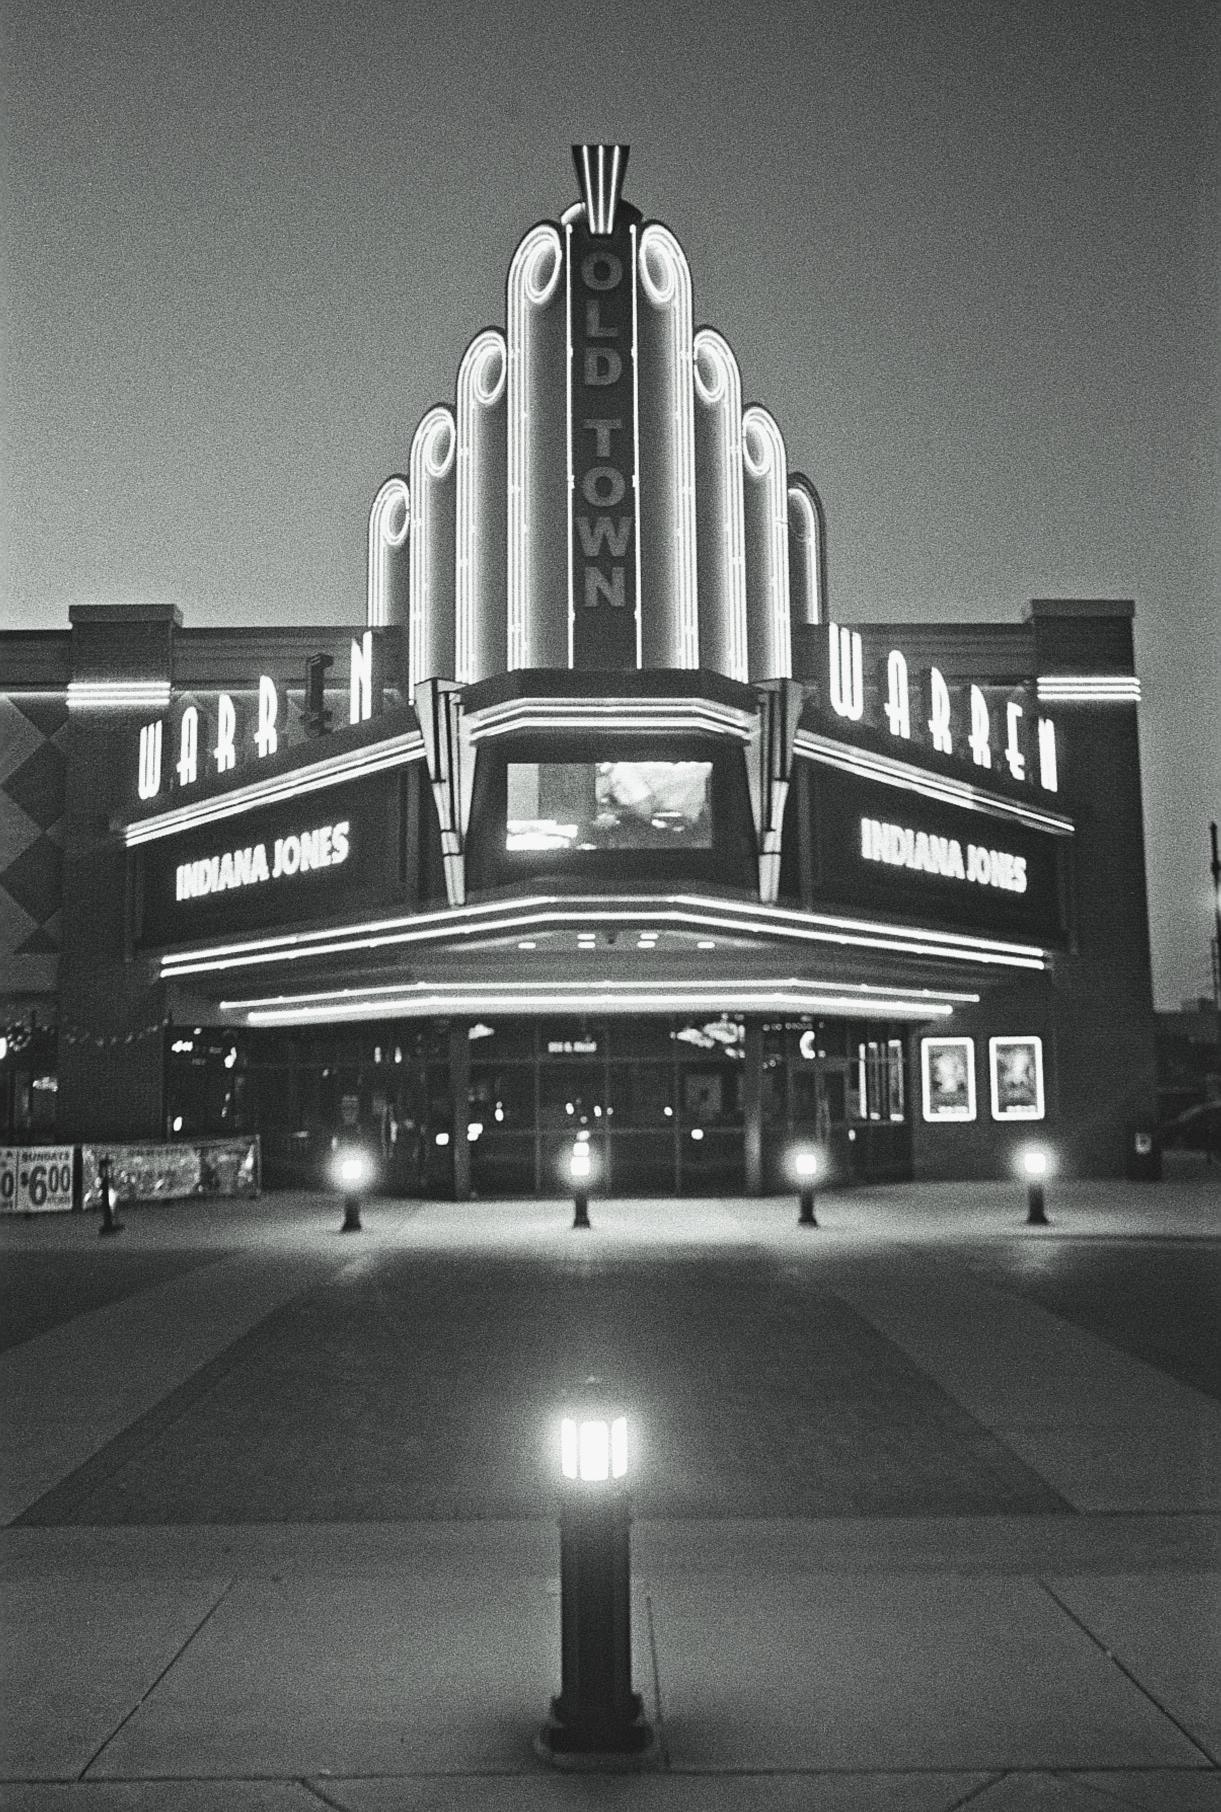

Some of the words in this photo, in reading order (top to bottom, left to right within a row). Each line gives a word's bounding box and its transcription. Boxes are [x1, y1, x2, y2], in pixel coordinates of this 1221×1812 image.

[581, 252, 623, 386] OLD
[574, 418, 633, 607] TOWN
[138, 630, 373, 800] WARREN
[828, 621, 1058, 792] WARREN
[175, 843, 270, 901] INDIANA
[272, 820, 350, 878] JONES
[861, 816, 966, 880] INDIANA
[966, 843, 1027, 893] JONES
